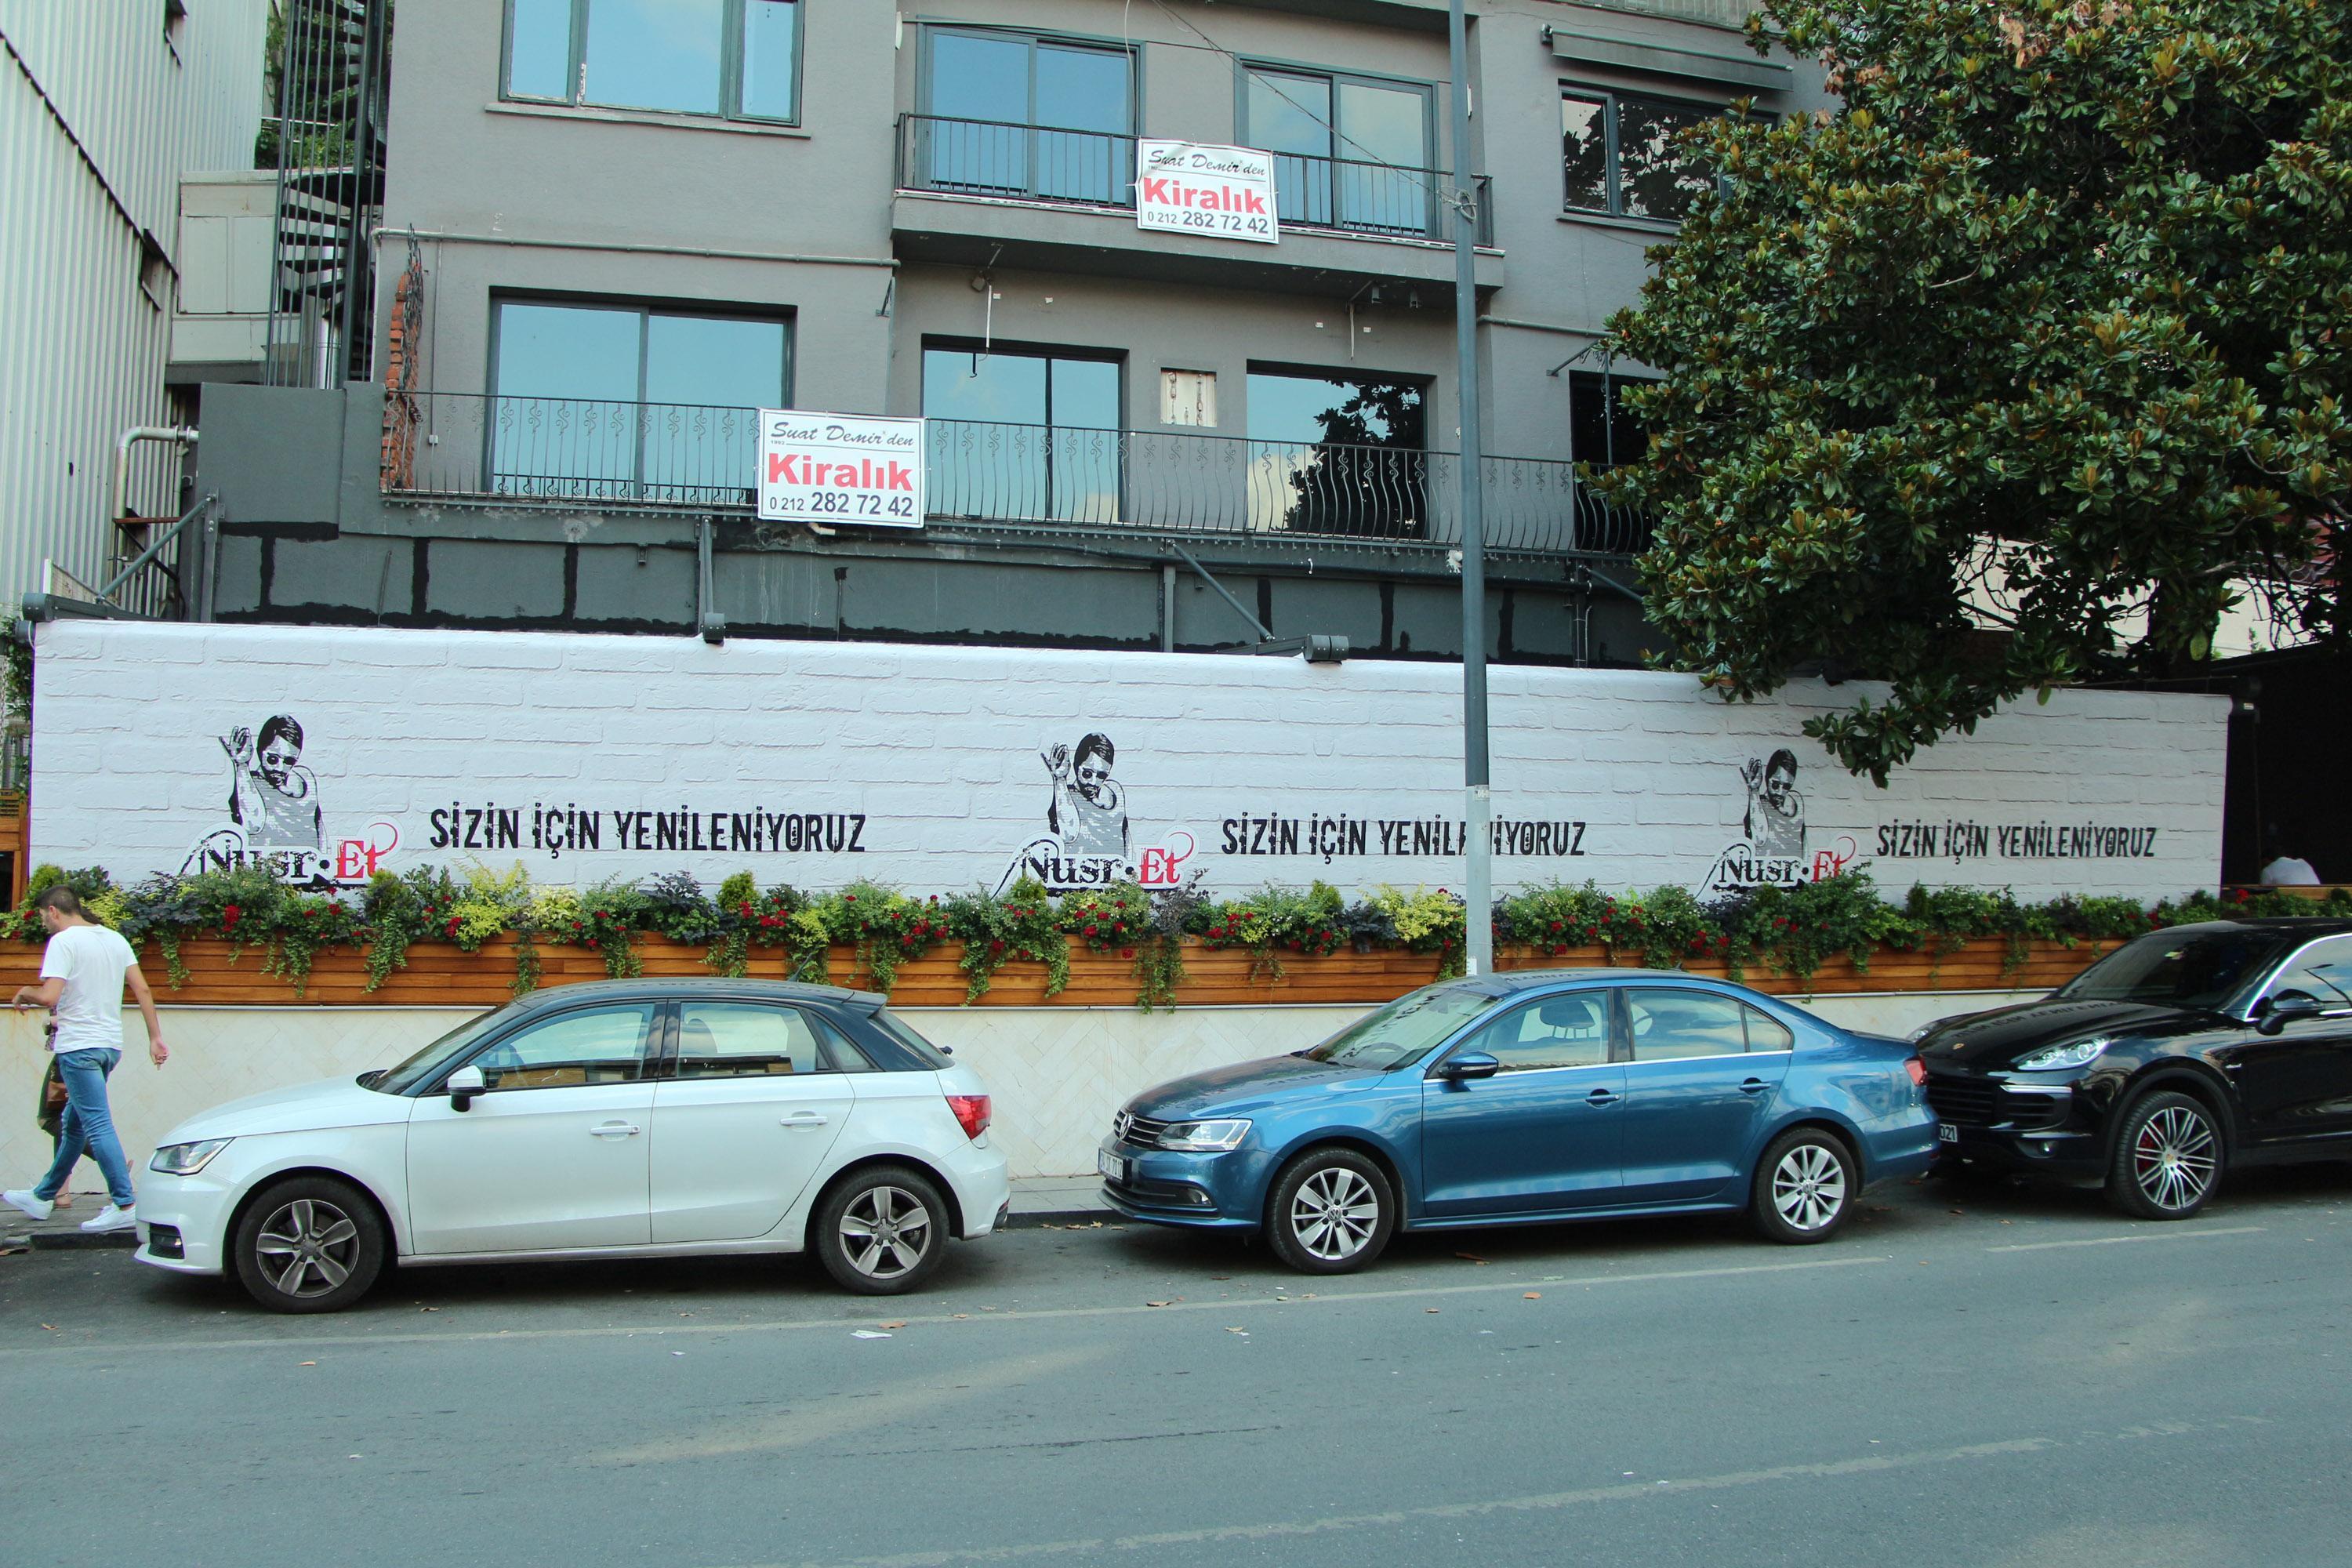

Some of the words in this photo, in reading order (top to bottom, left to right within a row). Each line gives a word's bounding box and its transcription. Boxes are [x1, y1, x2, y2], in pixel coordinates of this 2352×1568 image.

[1148, 150, 1185, 168] Suat
[1143, 177, 1267, 215] Kiralık
[1147, 211, 1154, 222] 0
[1157, 212, 1178, 224] 212
[1182, 210, 1215, 229] 282
[1220, 215, 1242, 231] 72
[1247, 217, 1269, 234] 42
[771, 421, 817, 441] Suat
[768, 452, 913, 492] Kiralık
[769, 496, 777, 510] 0
[781, 496, 804, 511] 212
[811, 492, 850, 513] 282
[856, 494, 881, 515] 72
[887, 496, 913, 517] 42
[430, 801, 519, 850] SİZİN
[534, 802, 600, 859] İÇİN
[614, 805, 866, 852] YENİLENİYORUZ
[1221, 811, 1298, 855] SİZİN
[1308, 812, 1367, 865] İÇİN
[1378, 814, 1586, 857] YENİLİYORUZ
[1876, 818, 1936, 858] SİZİN
[1944, 819, 1989, 865] İÇİN
[1998, 820, 2157, 858] YENİLENİYORUZ
